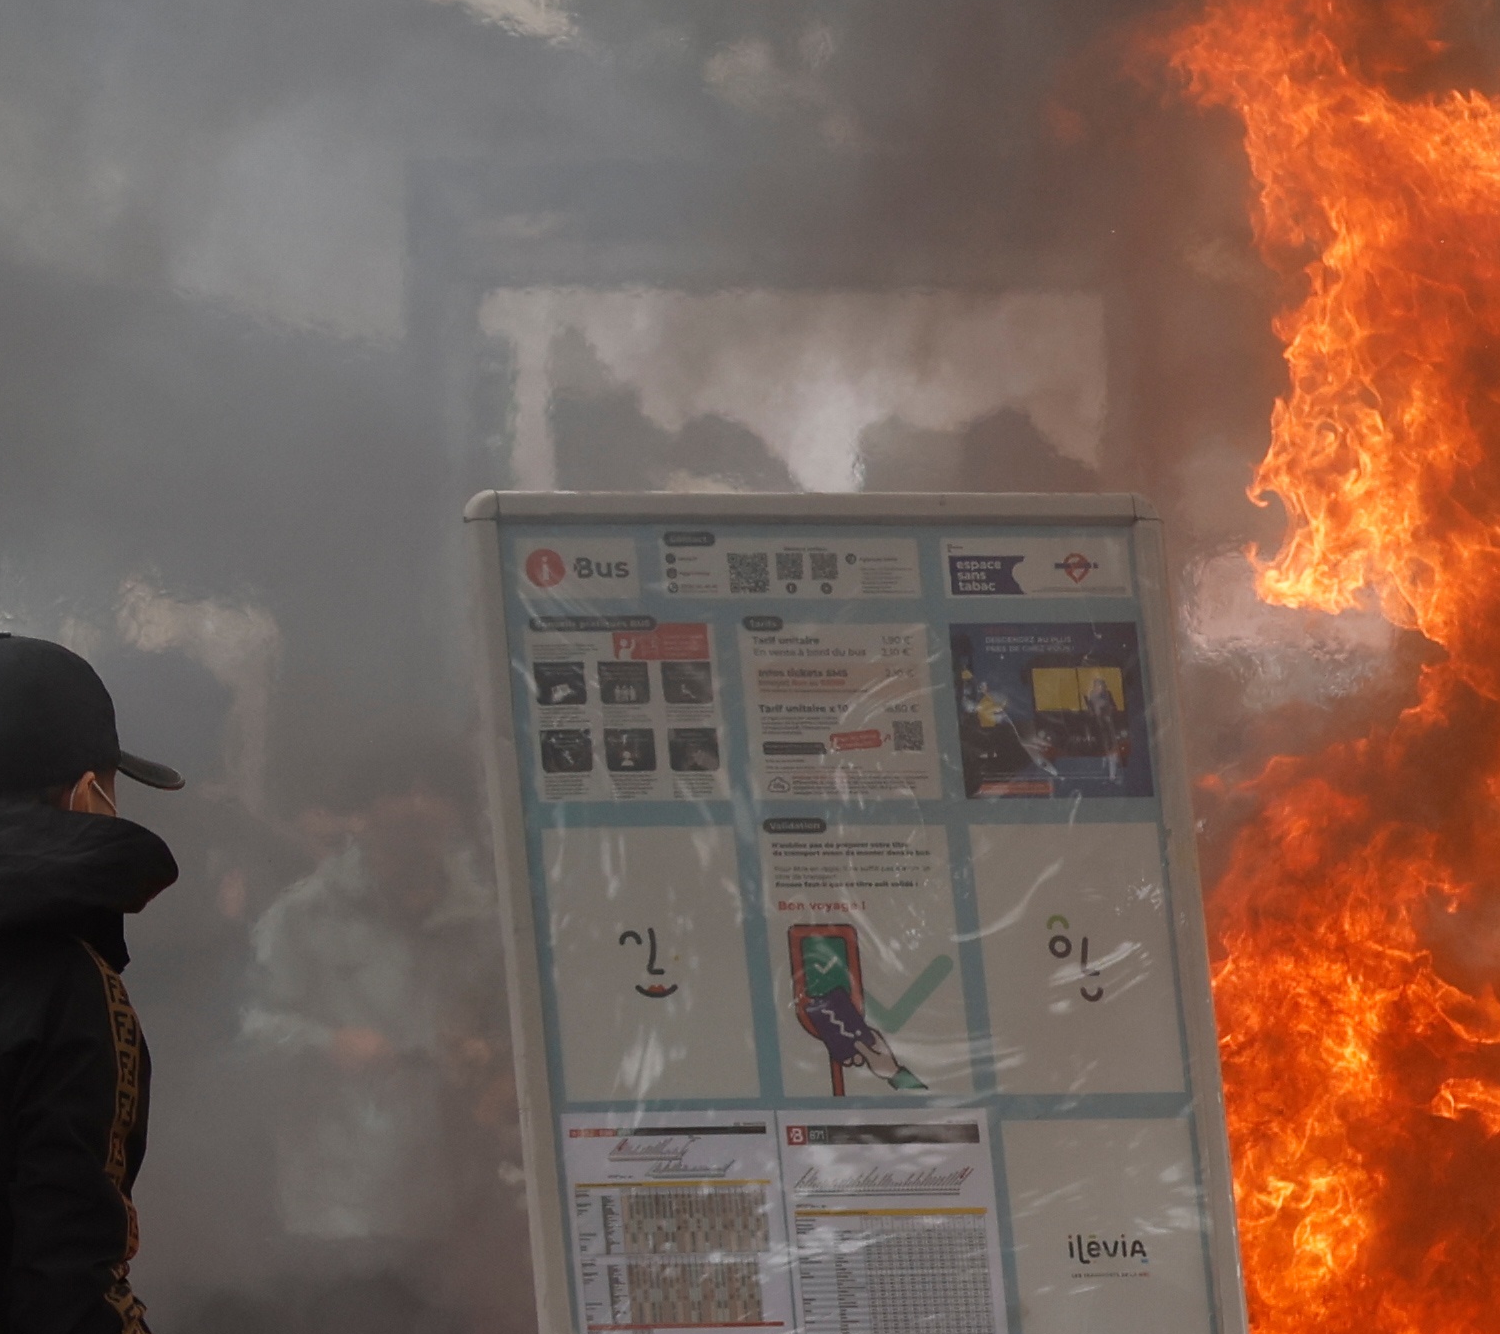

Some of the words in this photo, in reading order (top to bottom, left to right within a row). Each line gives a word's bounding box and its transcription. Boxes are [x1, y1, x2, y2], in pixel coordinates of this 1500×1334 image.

[574, 557, 630, 578] Bus
[956, 560, 1002, 571] espace
[957, 571, 987, 580] sans
[958, 581, 997, 591] tabac
[752, 636, 776, 645] Tarif
[778, 635, 820, 645] unitaire
[806, 647, 830, 656] bord
[832, 647, 846, 656] du
[848, 647, 866, 656] bus
[758, 704, 782, 713] Tarif
[785, 704, 827, 713] unitaire
[769, 821, 821, 831] Validation
[778, 900, 805, 911] Bon
[809, 901, 859, 913] voyage
